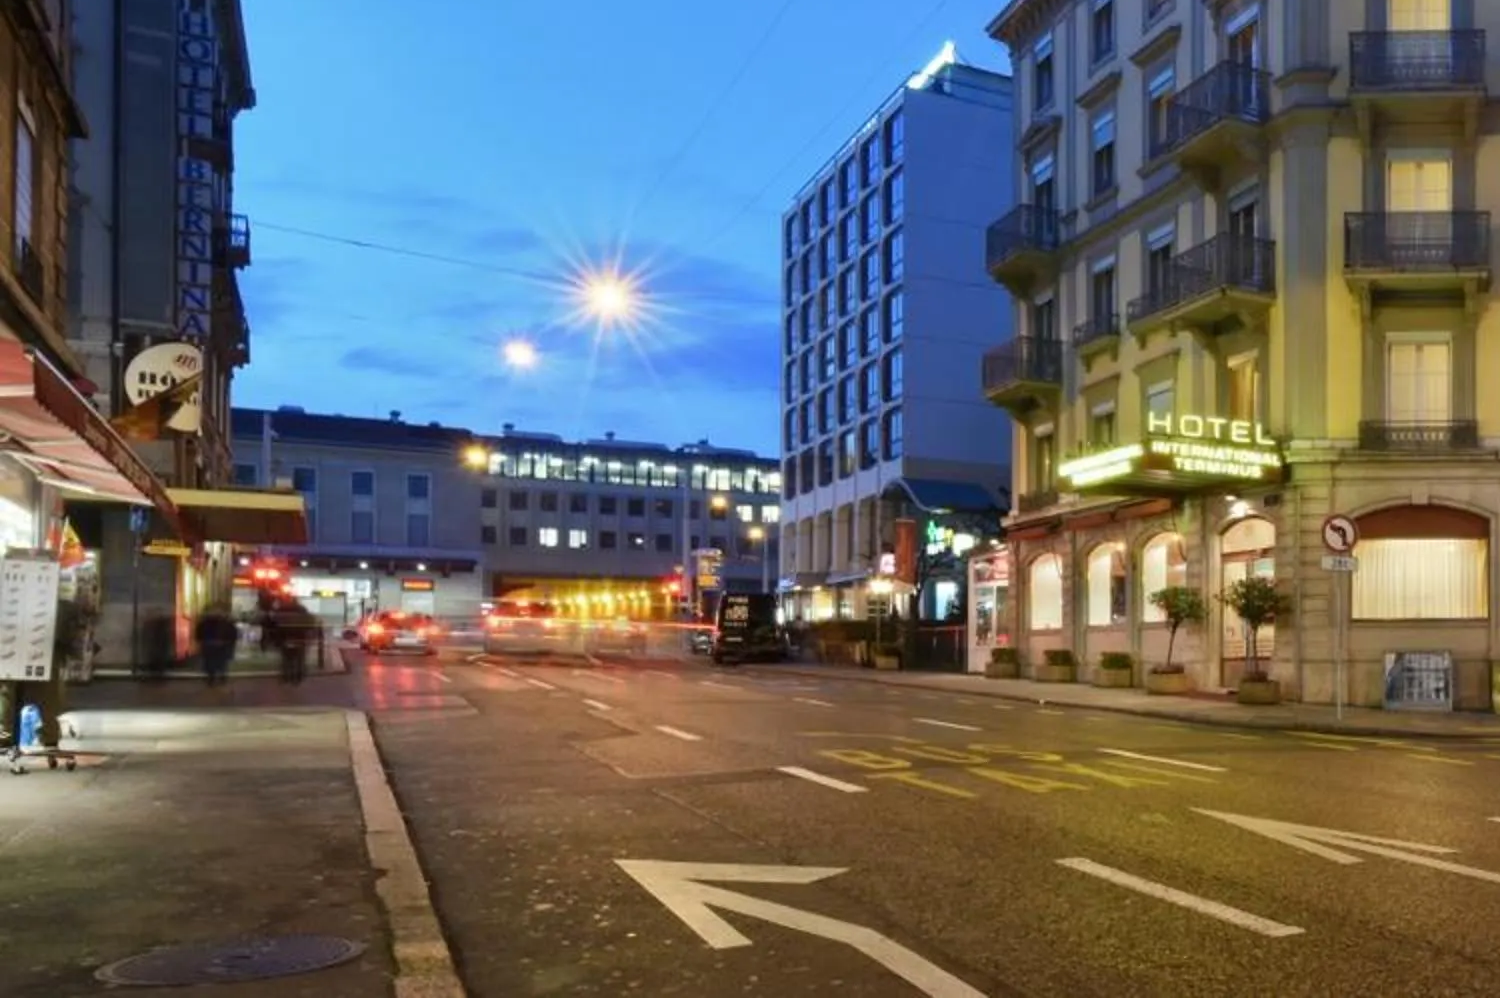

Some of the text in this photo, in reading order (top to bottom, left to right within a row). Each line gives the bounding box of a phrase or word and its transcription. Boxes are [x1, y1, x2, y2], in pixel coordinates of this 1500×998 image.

[180, 11, 211, 137] HOTEL
[181, 157, 208, 335] BERNINA
[1147, 411, 1277, 445] HOTEL
[1150, 440, 1282, 467] INTERNATIONAL
[1173, 456, 1263, 479] TERMINUS
